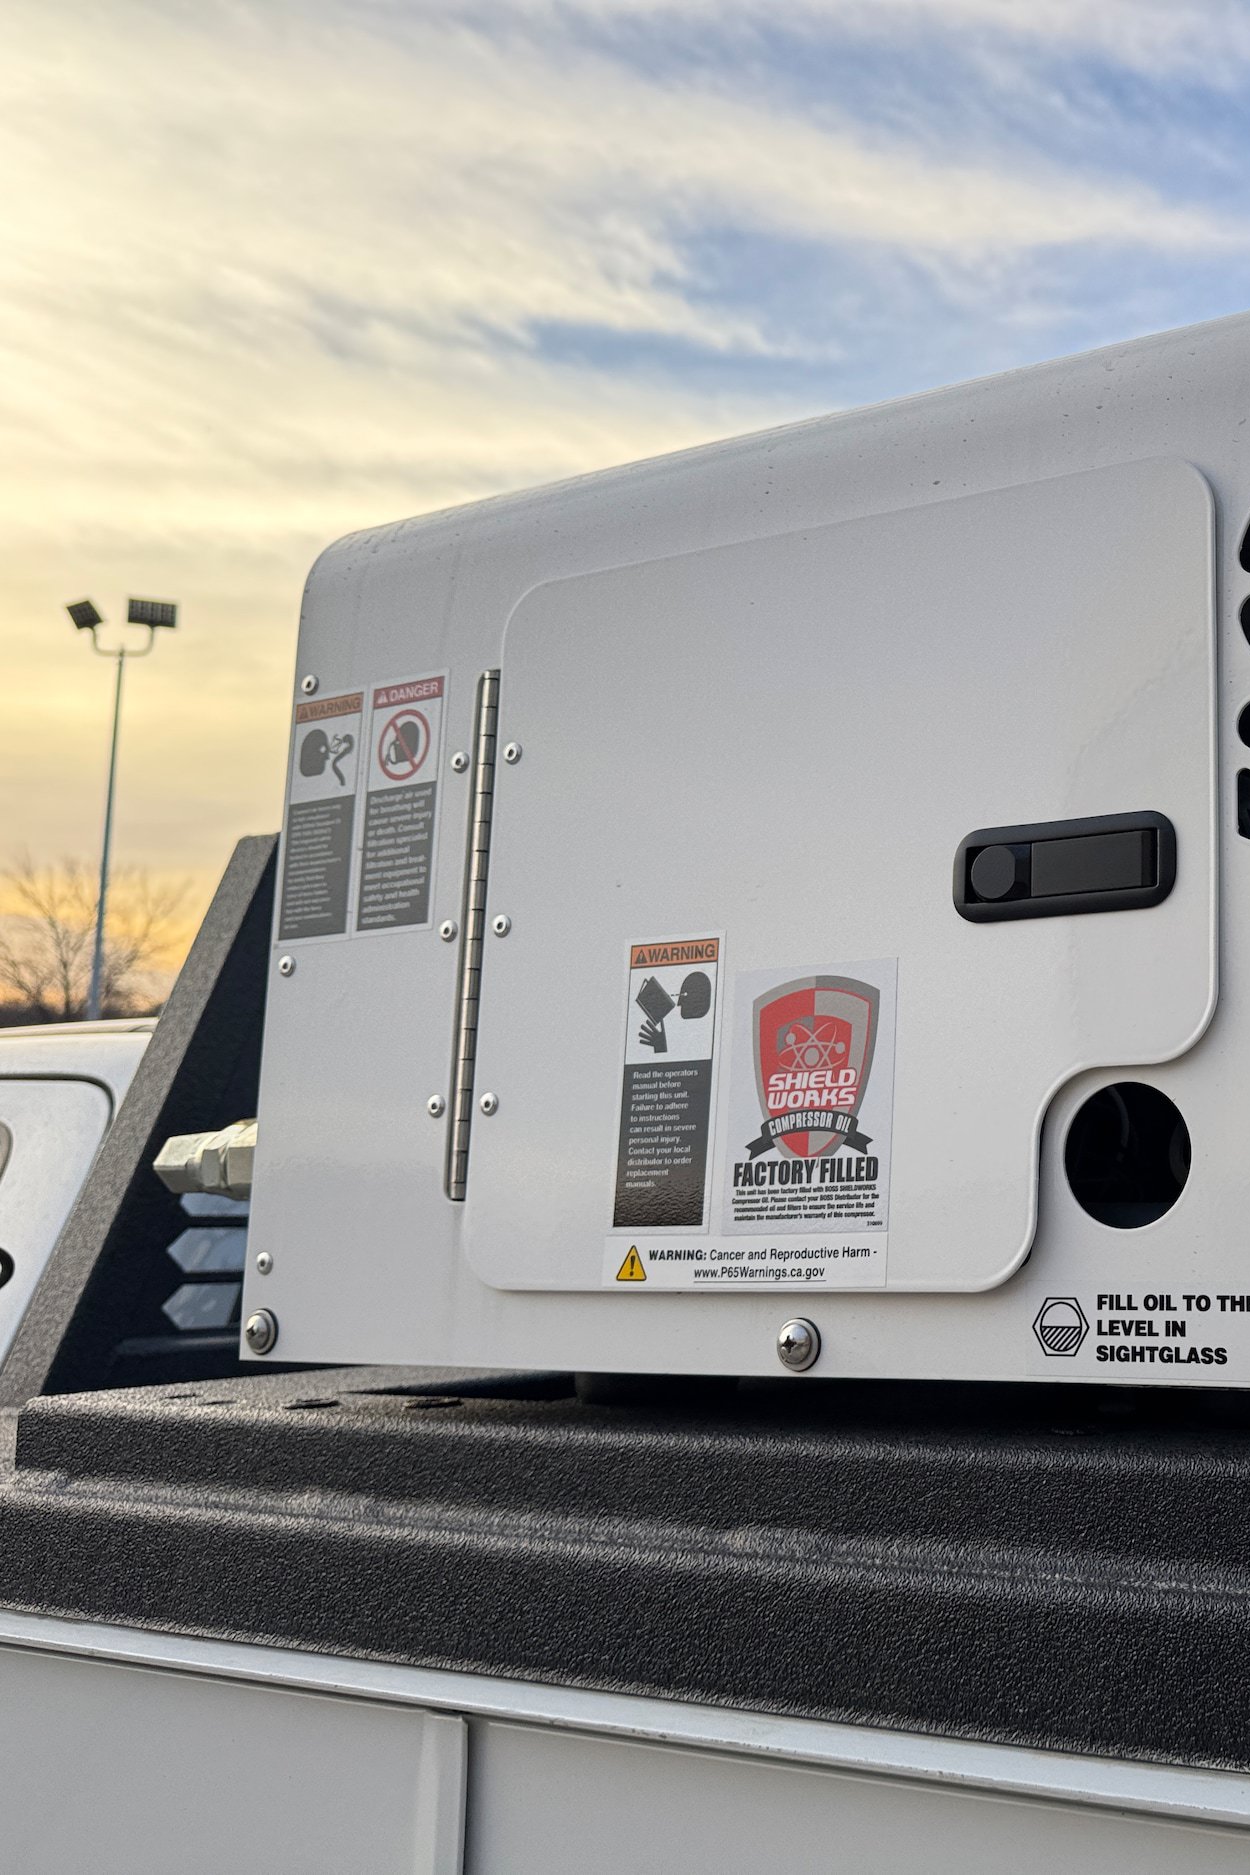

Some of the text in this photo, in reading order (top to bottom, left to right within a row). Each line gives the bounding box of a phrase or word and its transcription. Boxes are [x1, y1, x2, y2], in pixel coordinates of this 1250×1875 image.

[390, 682, 438, 702] DANGER
[310, 697, 360, 717] WARNING
[648, 944, 715, 962] WARNING
[633, 1071, 651, 1079] Read
[665, 1069, 698, 1078] operators
[768, 1069, 856, 1091] SHIELD
[633, 1082, 658, 1090] manual
[632, 1093, 658, 1101] starting
[768, 1087, 856, 1109] WORKS
[631, 1103, 655, 1111] Failure
[639, 1113, 680, 1121] instructions
[643, 1125, 663, 1133] result
[768, 1112, 851, 1136] COMPRESSOR OIL
[629, 1135, 682, 1146] personal injury.
[628, 1145, 691, 1155] Contact your local
[628, 1158, 663, 1166] distributor
[626, 1168, 669, 1178] replacement
[733, 1156, 879, 1187] FACTORY FILLED
[780, 1187, 798, 1195] factory
[804, 1212, 826, 1220] warranty
[649, 1249, 707, 1261] WARNING:
[710, 1249, 745, 1260] Cancer
[748, 1249, 767, 1259] and
[770, 1247, 840, 1263] Reproductive
[842, 1246, 871, 1258] Harm
[694, 1266, 825, 1280] www.P65Warnings.ca.gov
[1097, 1294, 1138, 1311] FILL
[1144, 1294, 1177, 1311] OIL
[1183, 1295, 1211, 1312] TO
[1097, 1320, 1186, 1337] LEVEL IN
[1096, 1345, 1227, 1365] SIGHTGLASS
